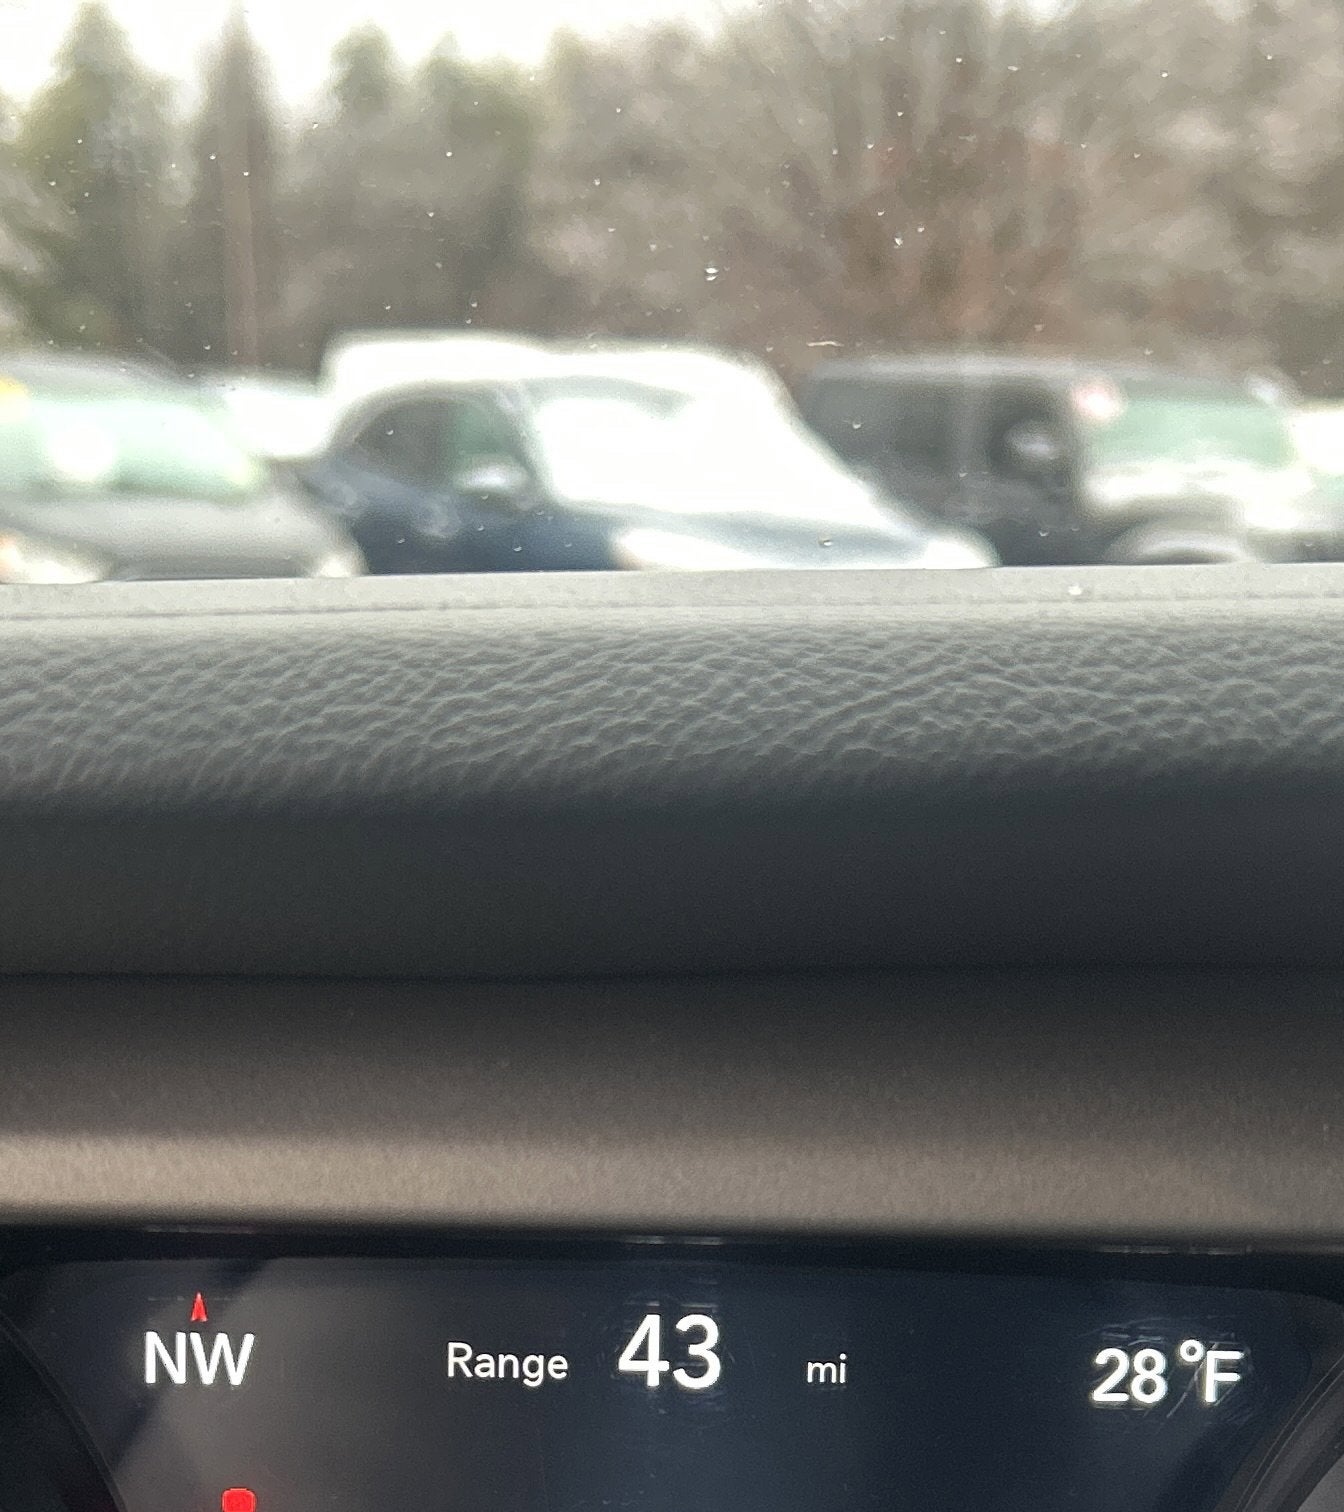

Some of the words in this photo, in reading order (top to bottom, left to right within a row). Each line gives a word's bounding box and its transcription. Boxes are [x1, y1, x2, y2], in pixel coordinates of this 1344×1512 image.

[145, 1331, 256, 1386] NW
[447, 1341, 569, 1388] Range
[618, 1314, 722, 1390] 43
[807, 1353, 847, 1384] mi
